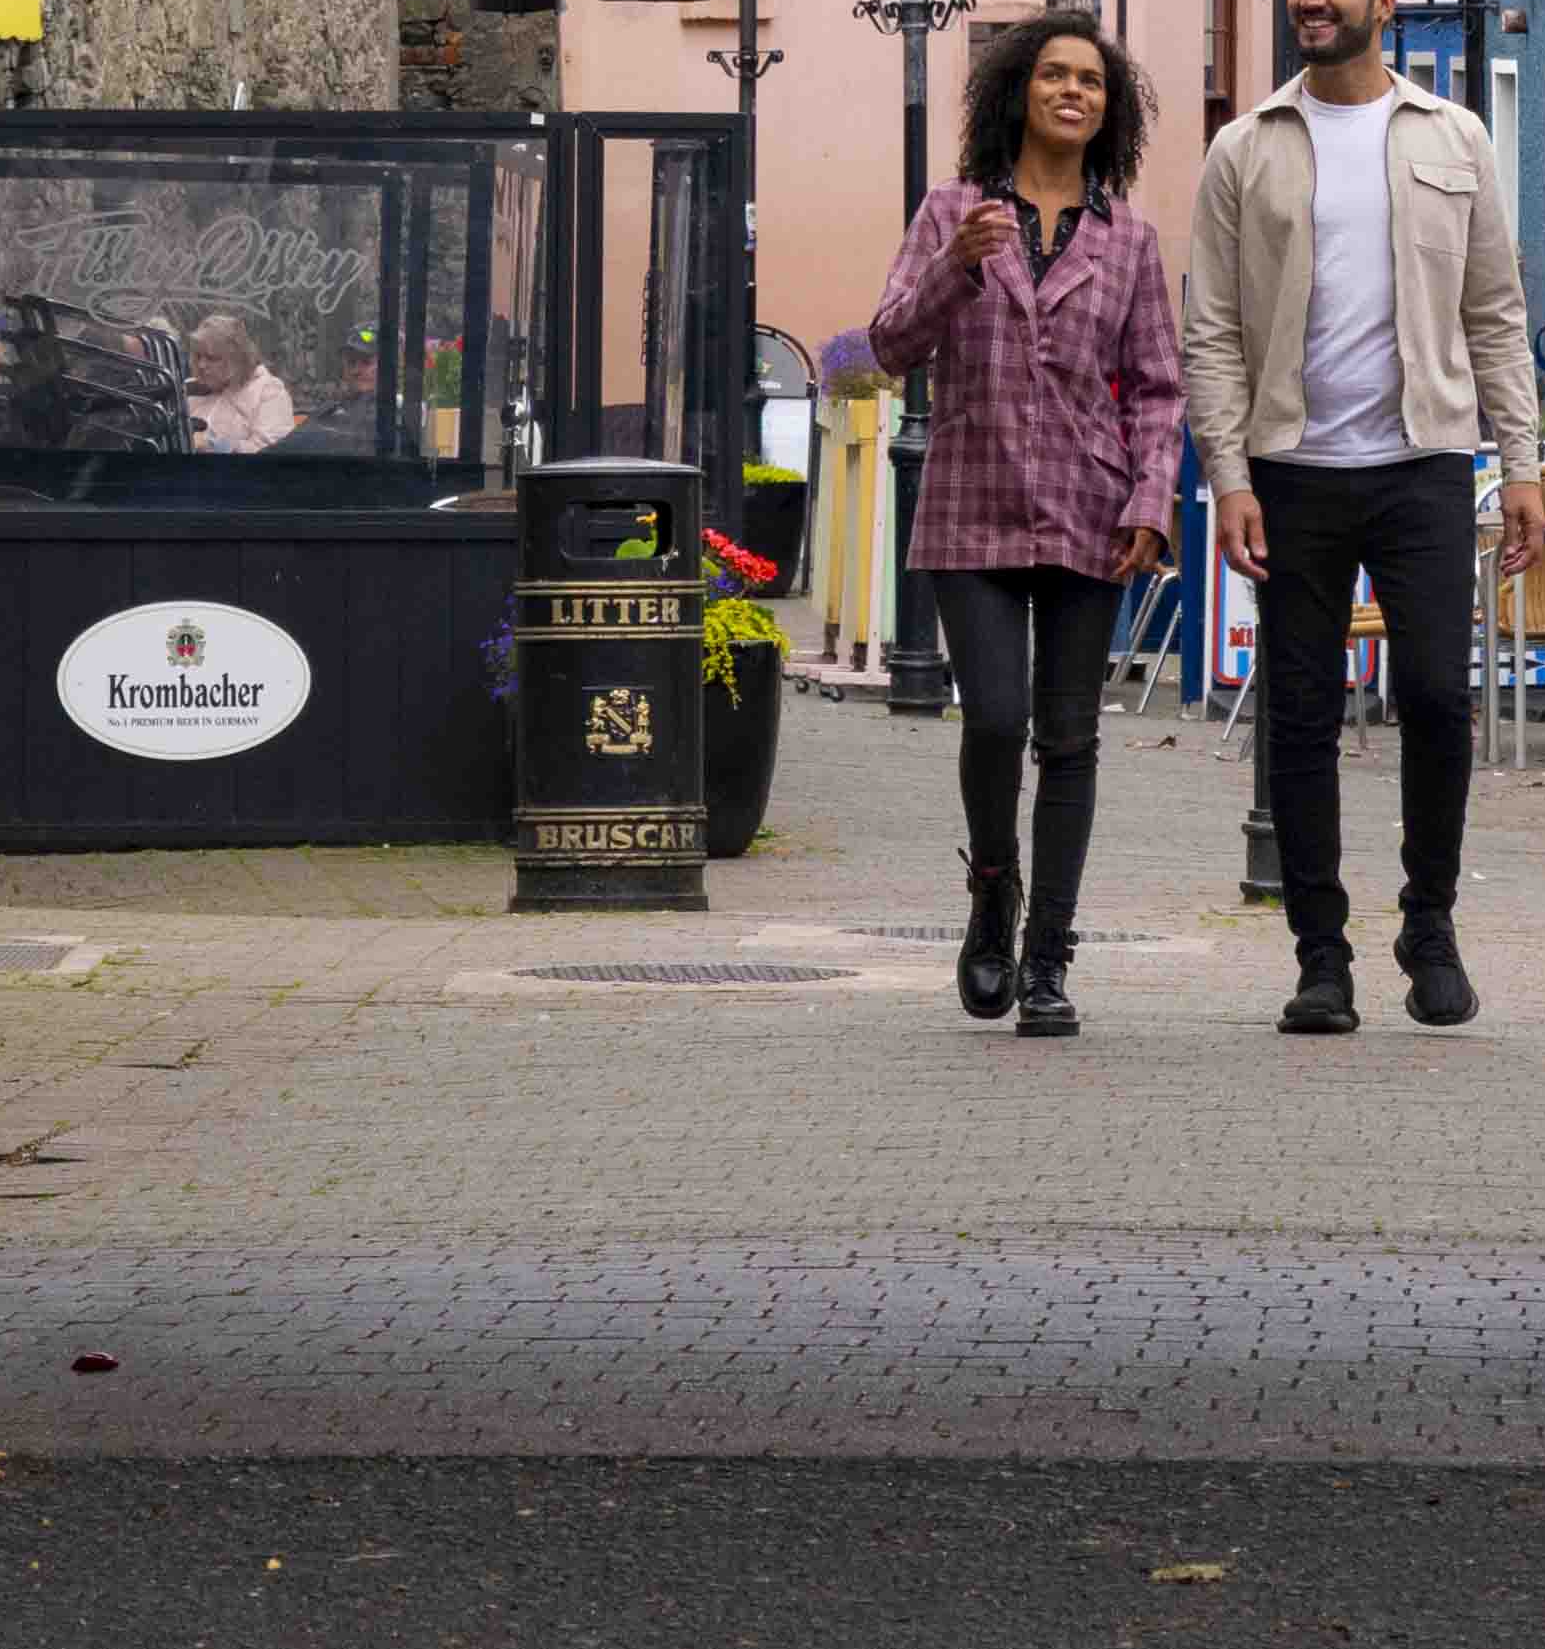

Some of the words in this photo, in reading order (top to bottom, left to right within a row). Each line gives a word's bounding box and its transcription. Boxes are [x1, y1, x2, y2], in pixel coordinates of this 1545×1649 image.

[551, 598, 680, 624] LITTER
[107, 673, 265, 709] Krombacher
[536, 823, 695, 849] BRUSCAR
